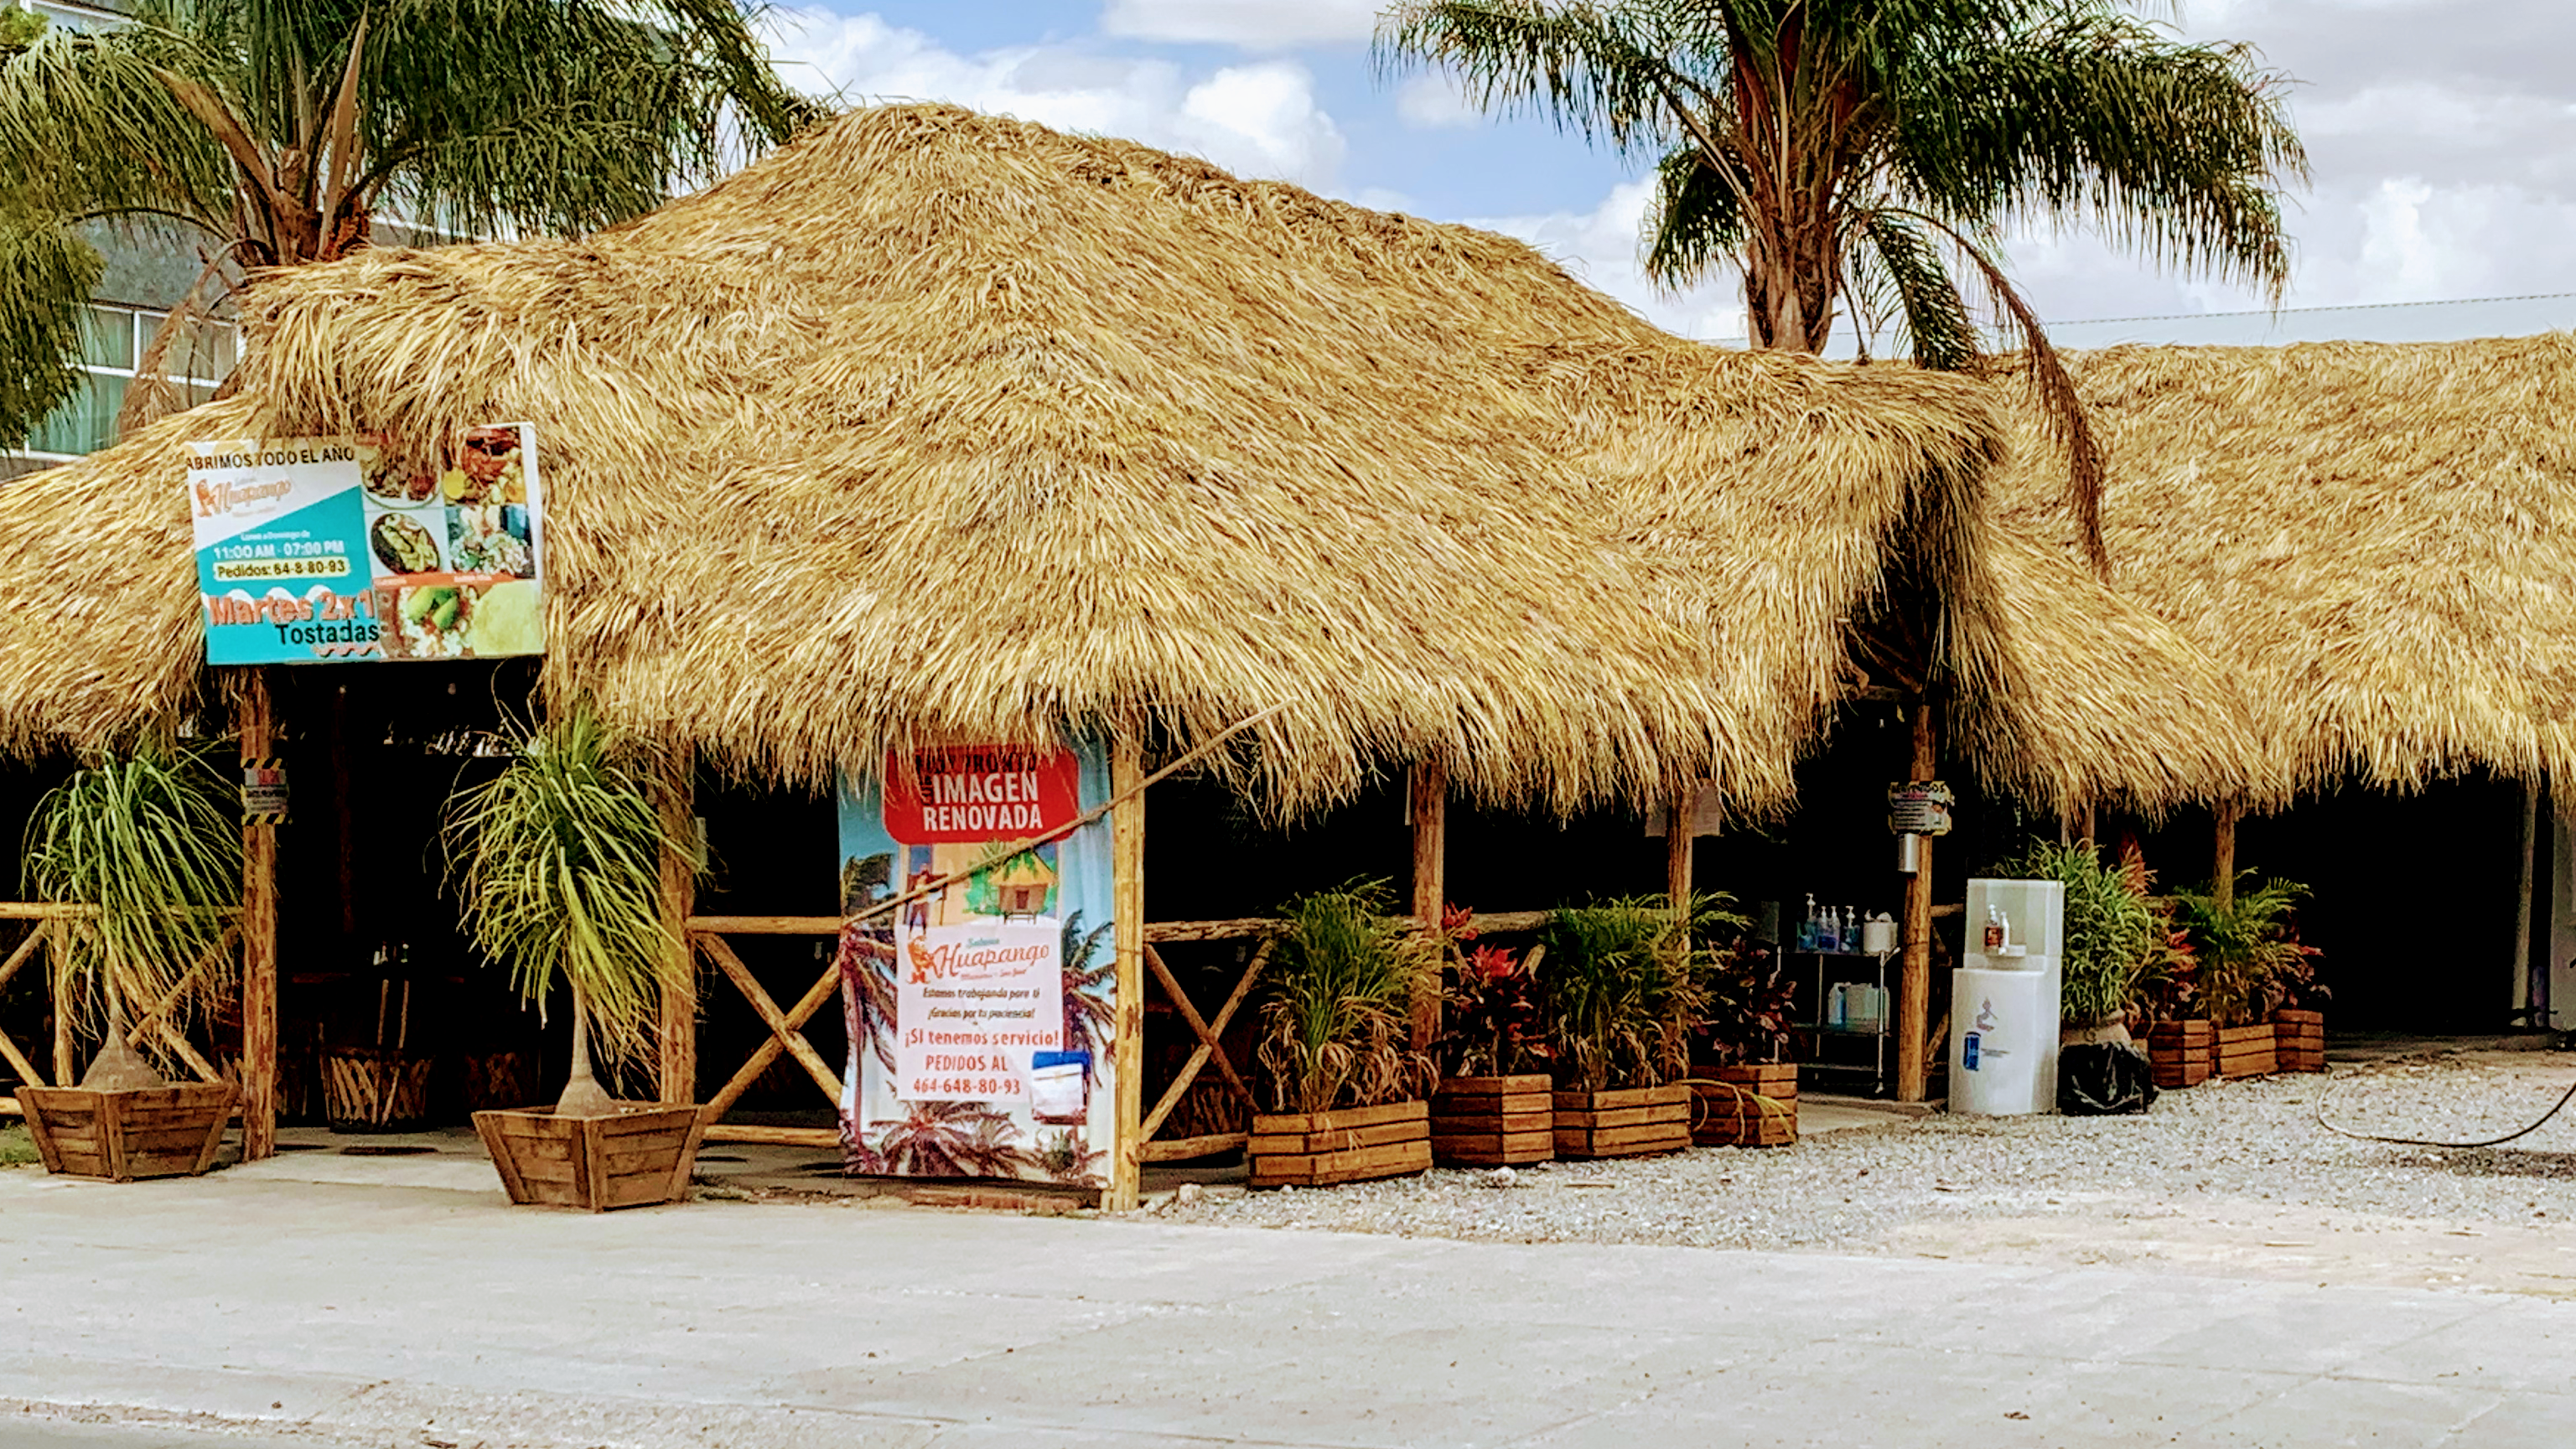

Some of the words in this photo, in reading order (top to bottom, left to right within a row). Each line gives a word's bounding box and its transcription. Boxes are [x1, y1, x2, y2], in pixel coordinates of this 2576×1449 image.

[186, 453, 252, 470] ABRIMOS
[257, 450, 298, 466] TODO
[301, 449, 319, 463] EL
[322, 444, 355, 462] AÑO
[214, 545, 252, 559] 11:00
[255, 544, 275, 557] AM
[283, 541, 322, 556] 07:00
[324, 541, 345, 554] PM
[209, 595, 314, 625] Martes
[275, 620, 380, 644] Tostadas
[933, 771, 1039, 804] IMAGEN
[923, 804, 1044, 831] RENOVADA
[932, 942, 1050, 979] Huapango
[928, 1031, 987, 1045] tenemos
[993, 1030, 1060, 1046] servicio!
[925, 1054, 987, 1072] PEDIDOS
[991, 1055, 1008, 1071] AL
[913, 1078, 1021, 1095] 464-648-80-93
